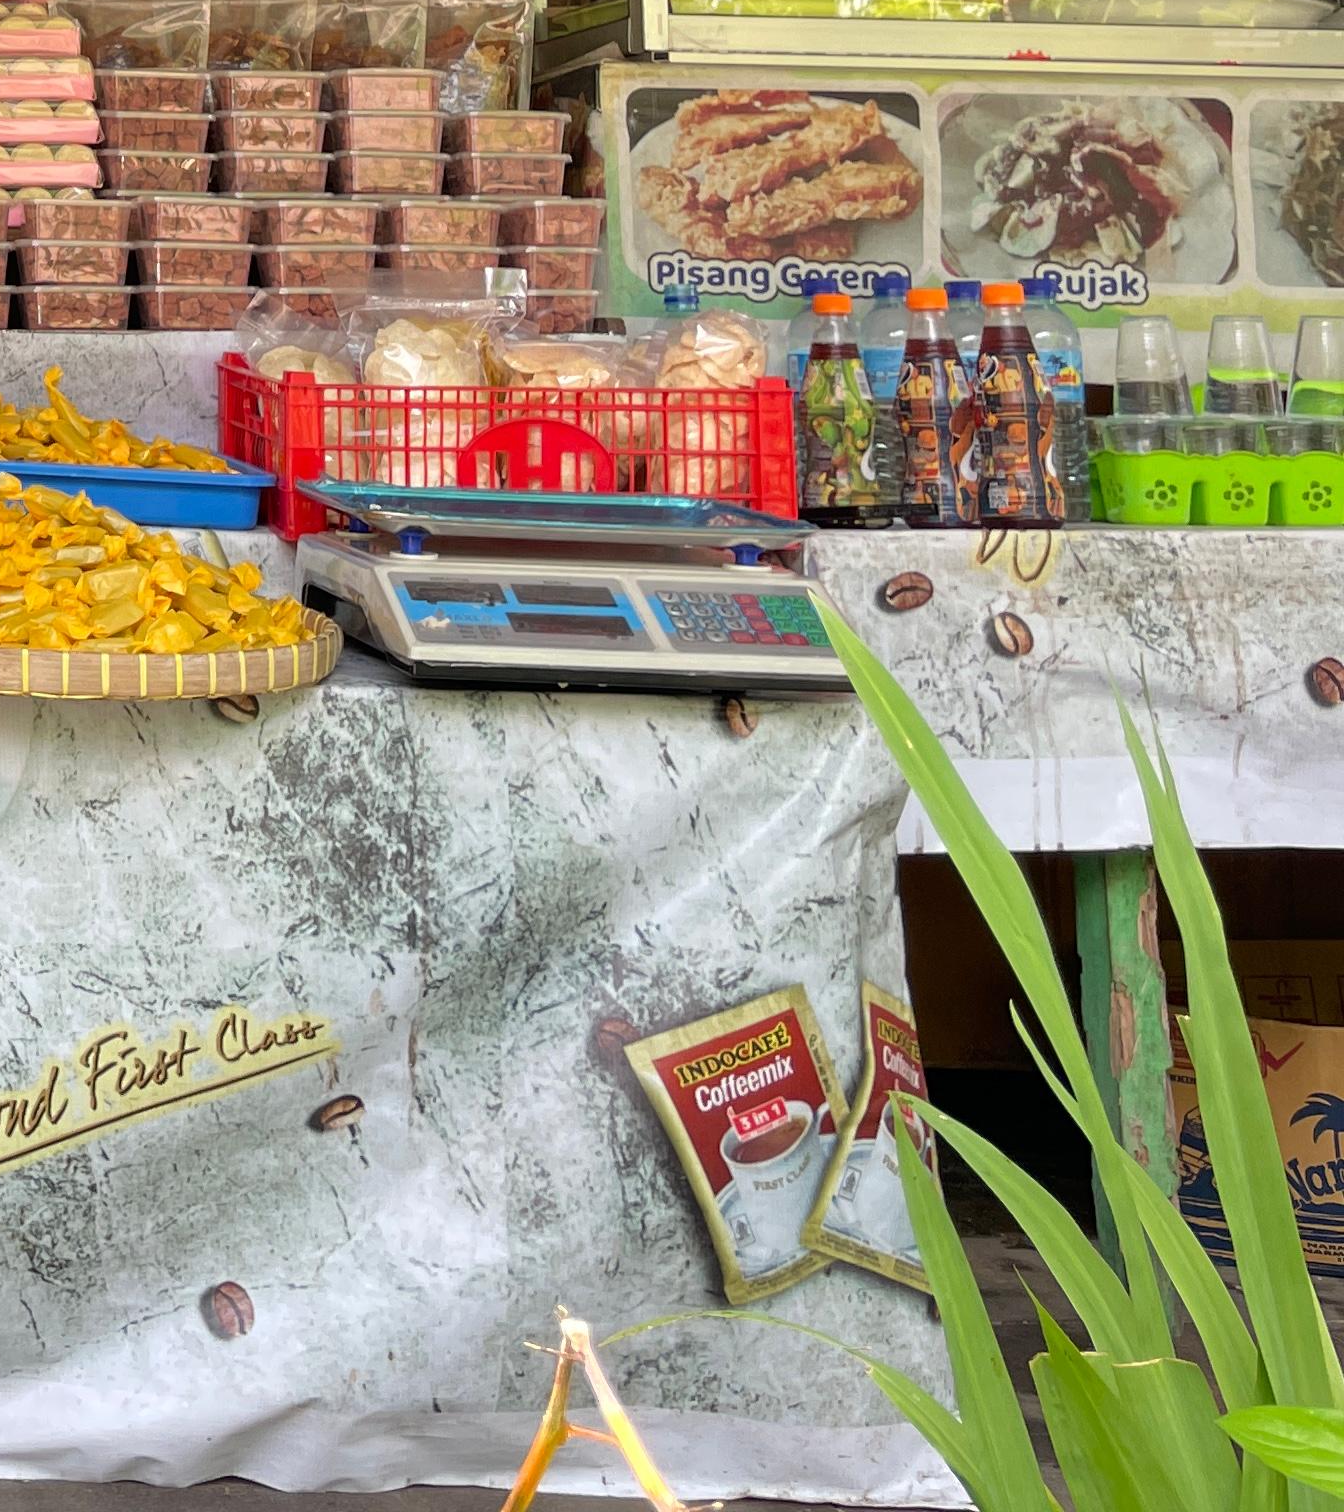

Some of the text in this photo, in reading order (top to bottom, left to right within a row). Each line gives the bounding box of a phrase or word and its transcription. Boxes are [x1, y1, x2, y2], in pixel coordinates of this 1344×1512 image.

[656, 261, 770, 293] Pisang
[79, 1029, 201, 1110] First
[215, 1013, 324, 1063] Class
[676, 1024, 790, 1085] INDOCAFÉ
[694, 1054, 794, 1112] Coffeemix
[752, 1110, 770, 1127] in
